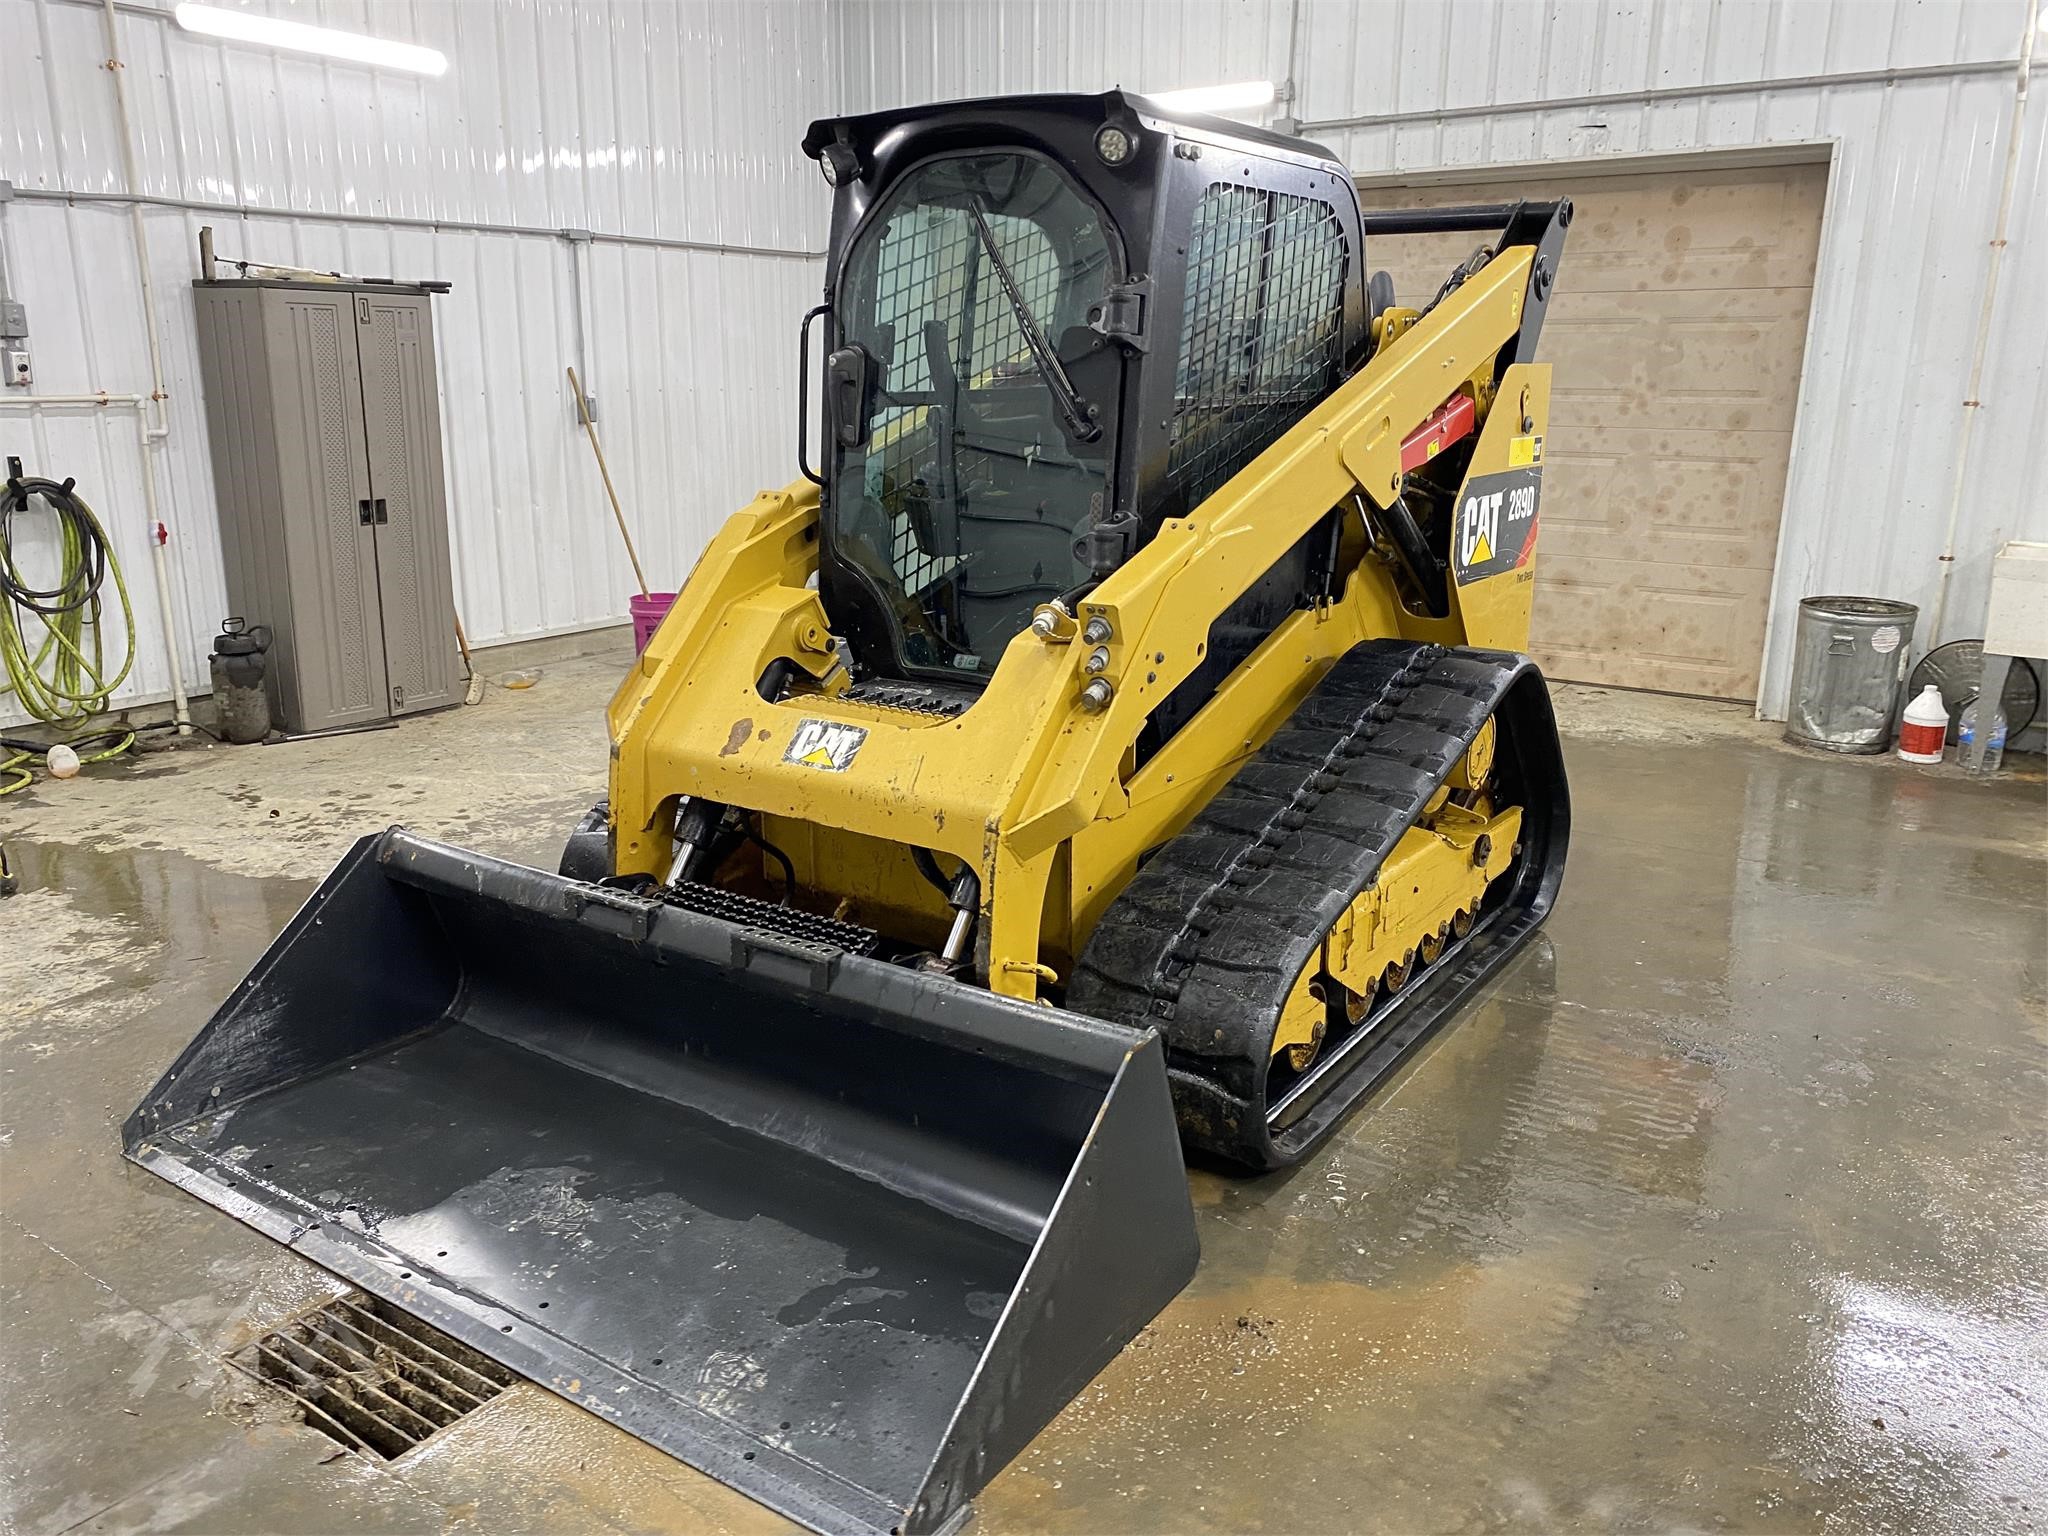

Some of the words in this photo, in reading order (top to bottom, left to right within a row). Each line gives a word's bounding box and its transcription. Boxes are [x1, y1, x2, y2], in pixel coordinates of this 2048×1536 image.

[1462, 492, 1503, 567] CAT
[1508, 485, 1535, 522] 289D
[790, 724, 861, 768] CAT
